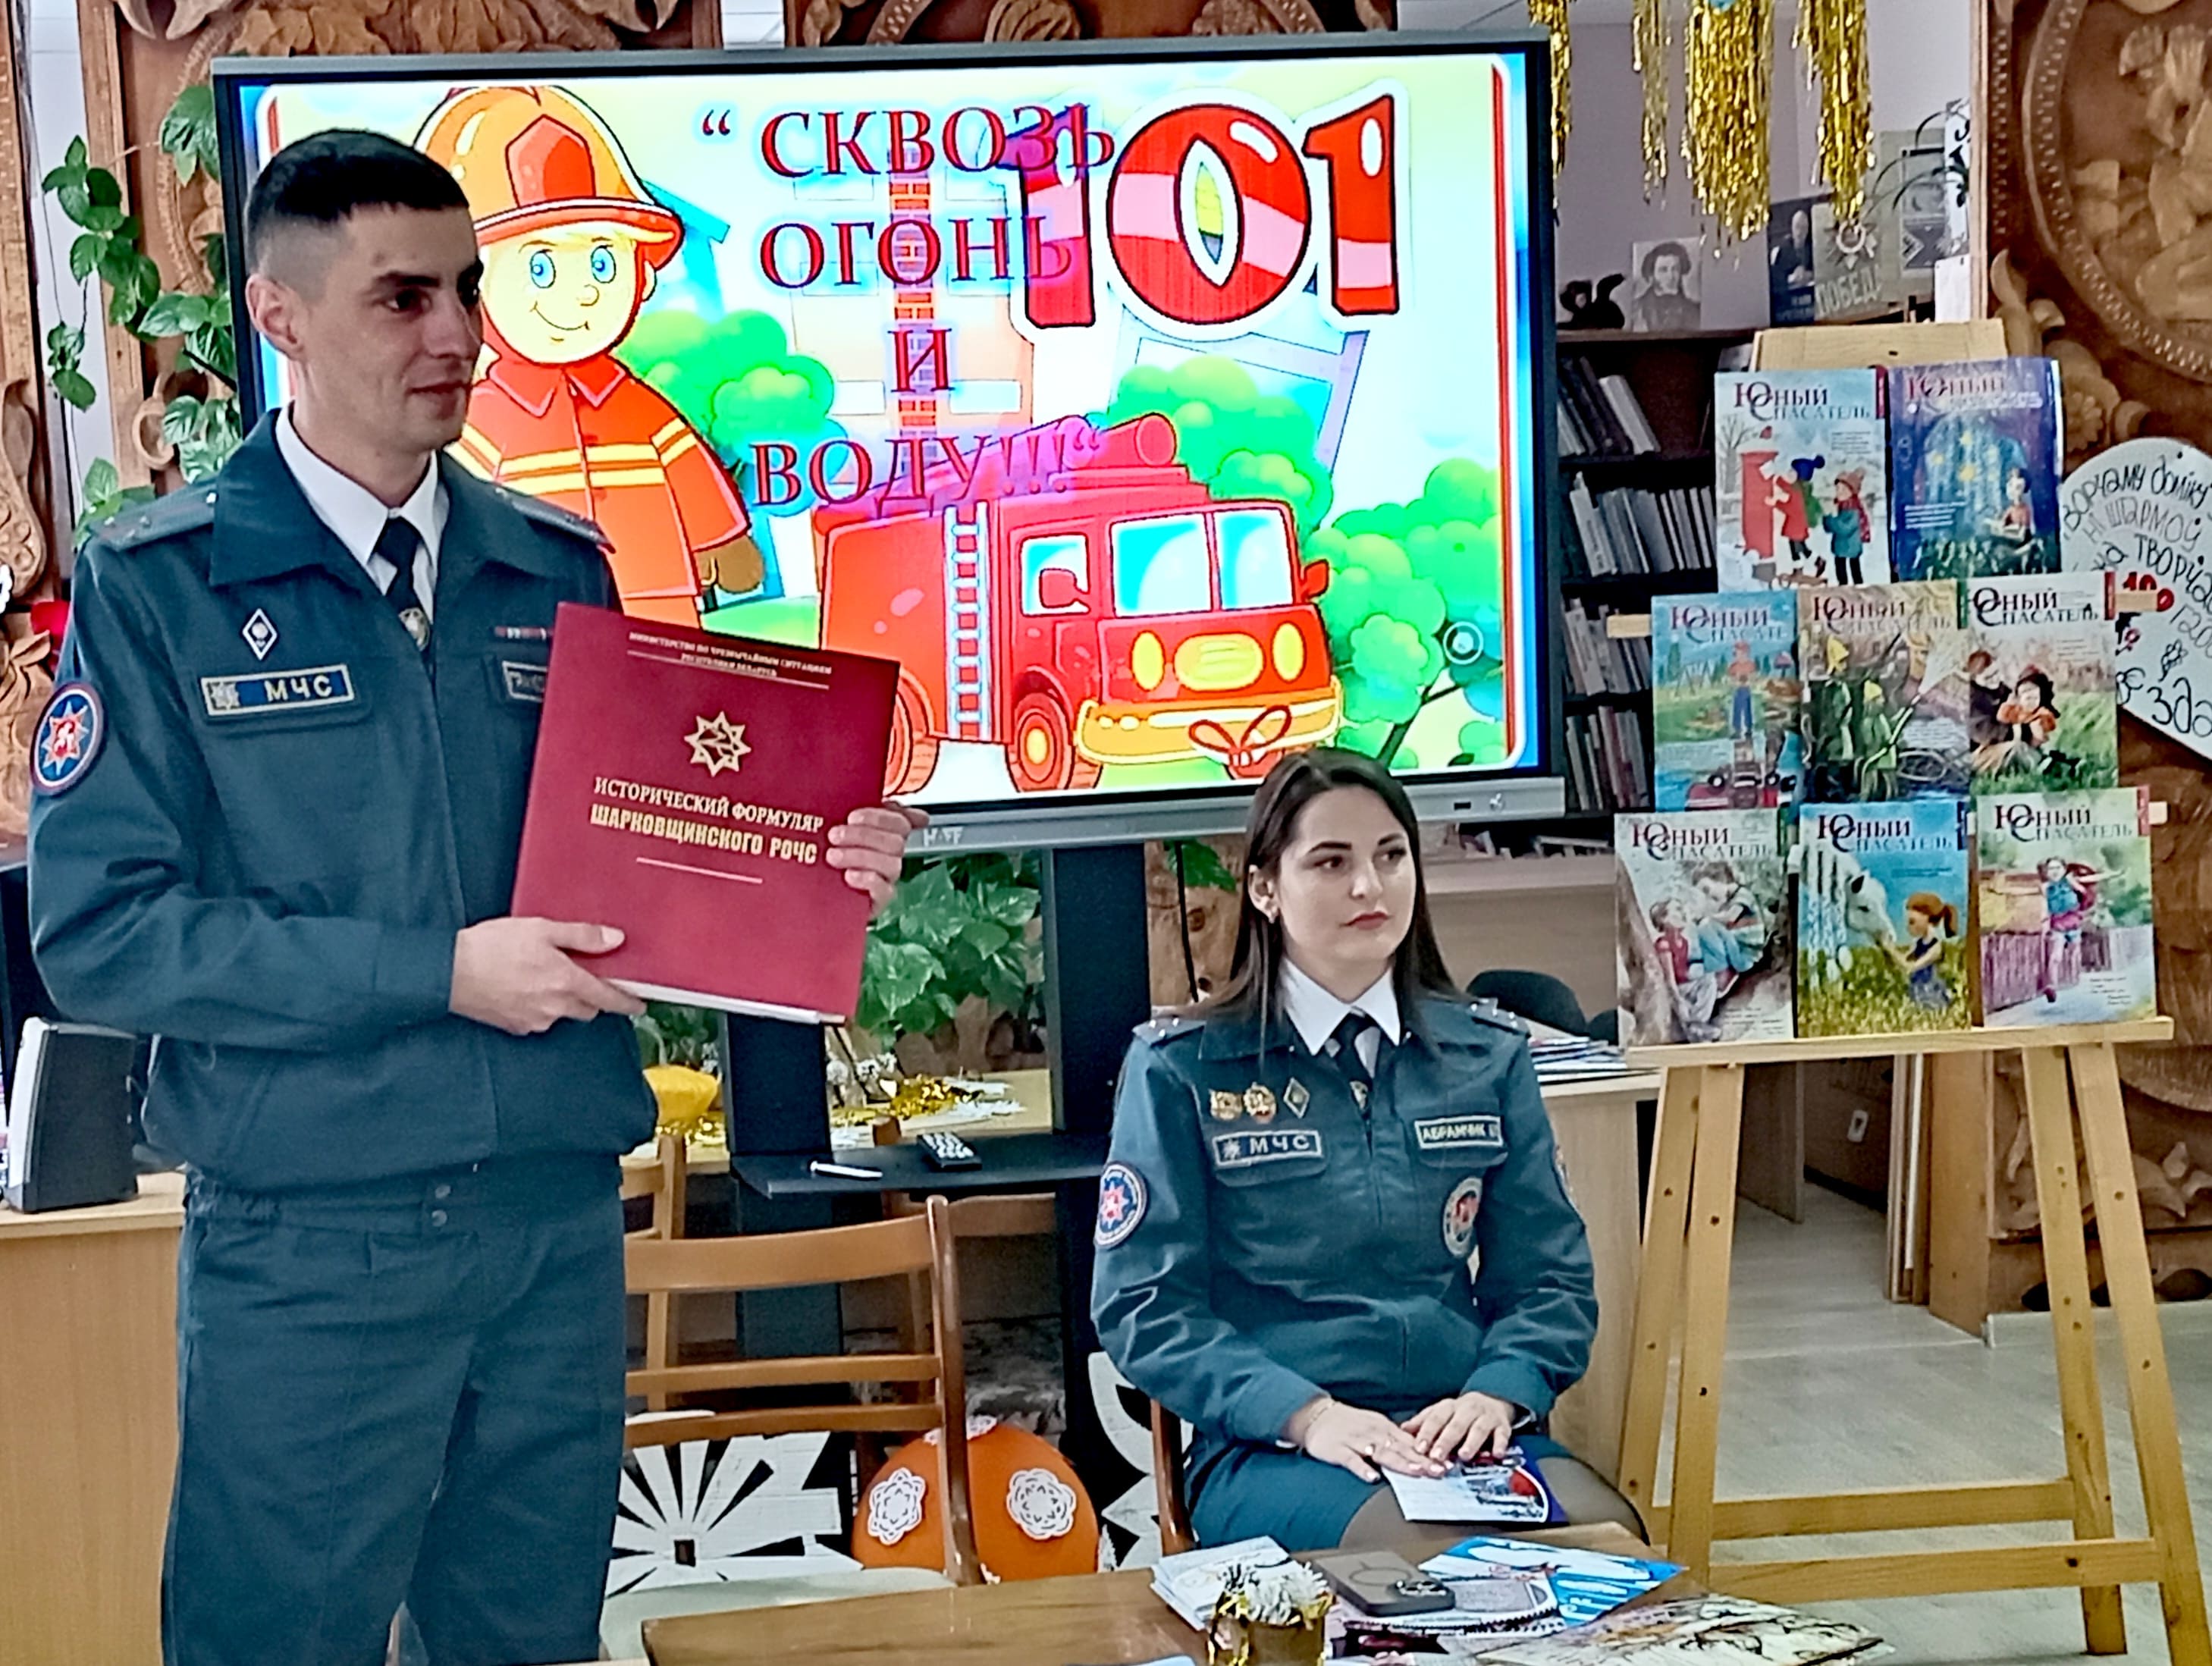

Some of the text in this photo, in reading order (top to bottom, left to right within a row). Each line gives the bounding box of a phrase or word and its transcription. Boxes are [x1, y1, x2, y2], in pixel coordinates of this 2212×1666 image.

[761, 103, 1115, 180] СКВОЗЬ
[998, 93, 1401, 328] 101
[760, 215, 1072, 289] ОГОНЬ
[887, 326, 953, 395] И
[265, 674, 333, 704] МЧС
[590, 804, 817, 864] ШАРКОВЩИНСКОГО РОЧС
[594, 777, 824, 833] ИСТОРИЧЕСКИЙ ФОРМУЛЯР
[1250, 1134, 1310, 1155] МЧС
